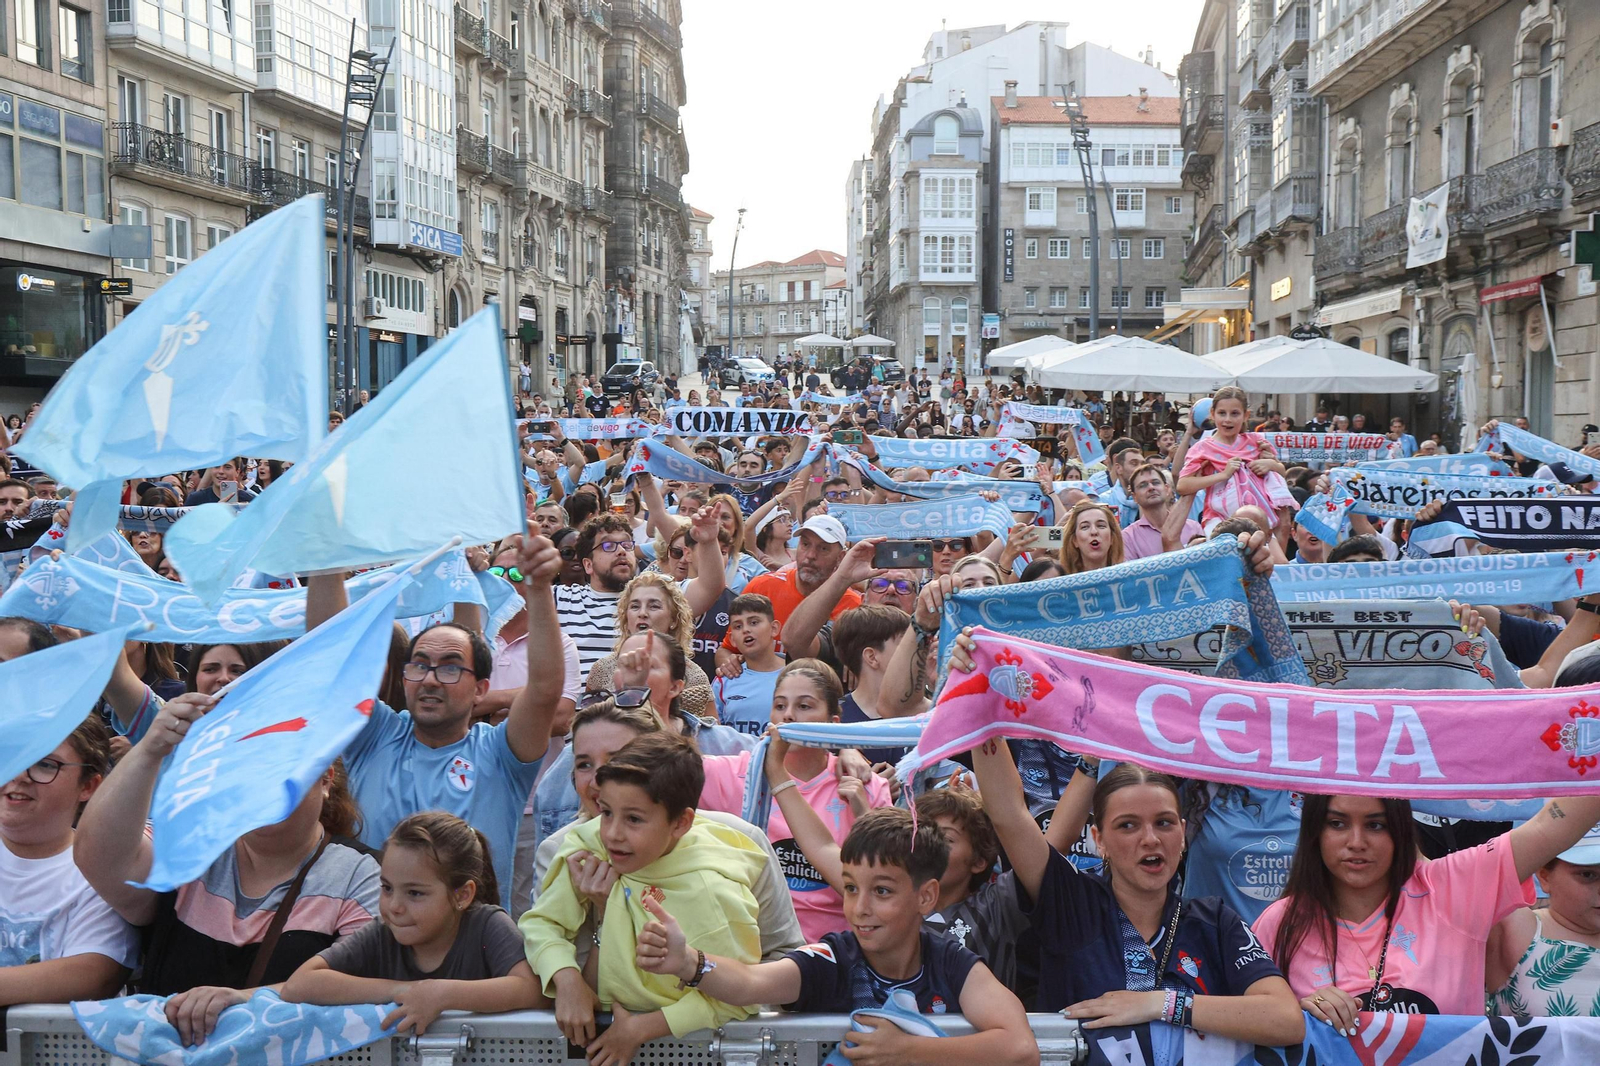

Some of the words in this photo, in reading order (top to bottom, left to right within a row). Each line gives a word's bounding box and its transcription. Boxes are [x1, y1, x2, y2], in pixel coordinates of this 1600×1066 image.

[410, 222, 443, 250] PSICA
[1005, 230, 1013, 275] HOTEL
[1274, 434, 1318, 449] CELTA
[1323, 436, 1343, 449] DE
[1348, 436, 1386, 450] VIGO
[1029, 493, 1042, 501] 23
[1457, 505, 1552, 530] FEITO
[1288, 564, 1357, 582] NOSA
[1363, 552, 1549, 578] RECONQUISTA
[1037, 567, 1211, 625] CELTA
[1295, 588, 1347, 601] FINAL
[1356, 583, 1446, 600] TEMPADA
[1453, 579, 1522, 596] 2018-19
[1286, 610, 1335, 624] THE
[1354, 610, 1412, 623] BEST
[1335, 629, 1454, 662] VIGO
[1135, 683, 1447, 779] CELTA
[776, 846, 809, 864] Estre
[1243, 854, 1293, 869] Estrell
[1245, 869, 1290, 885] Galici
